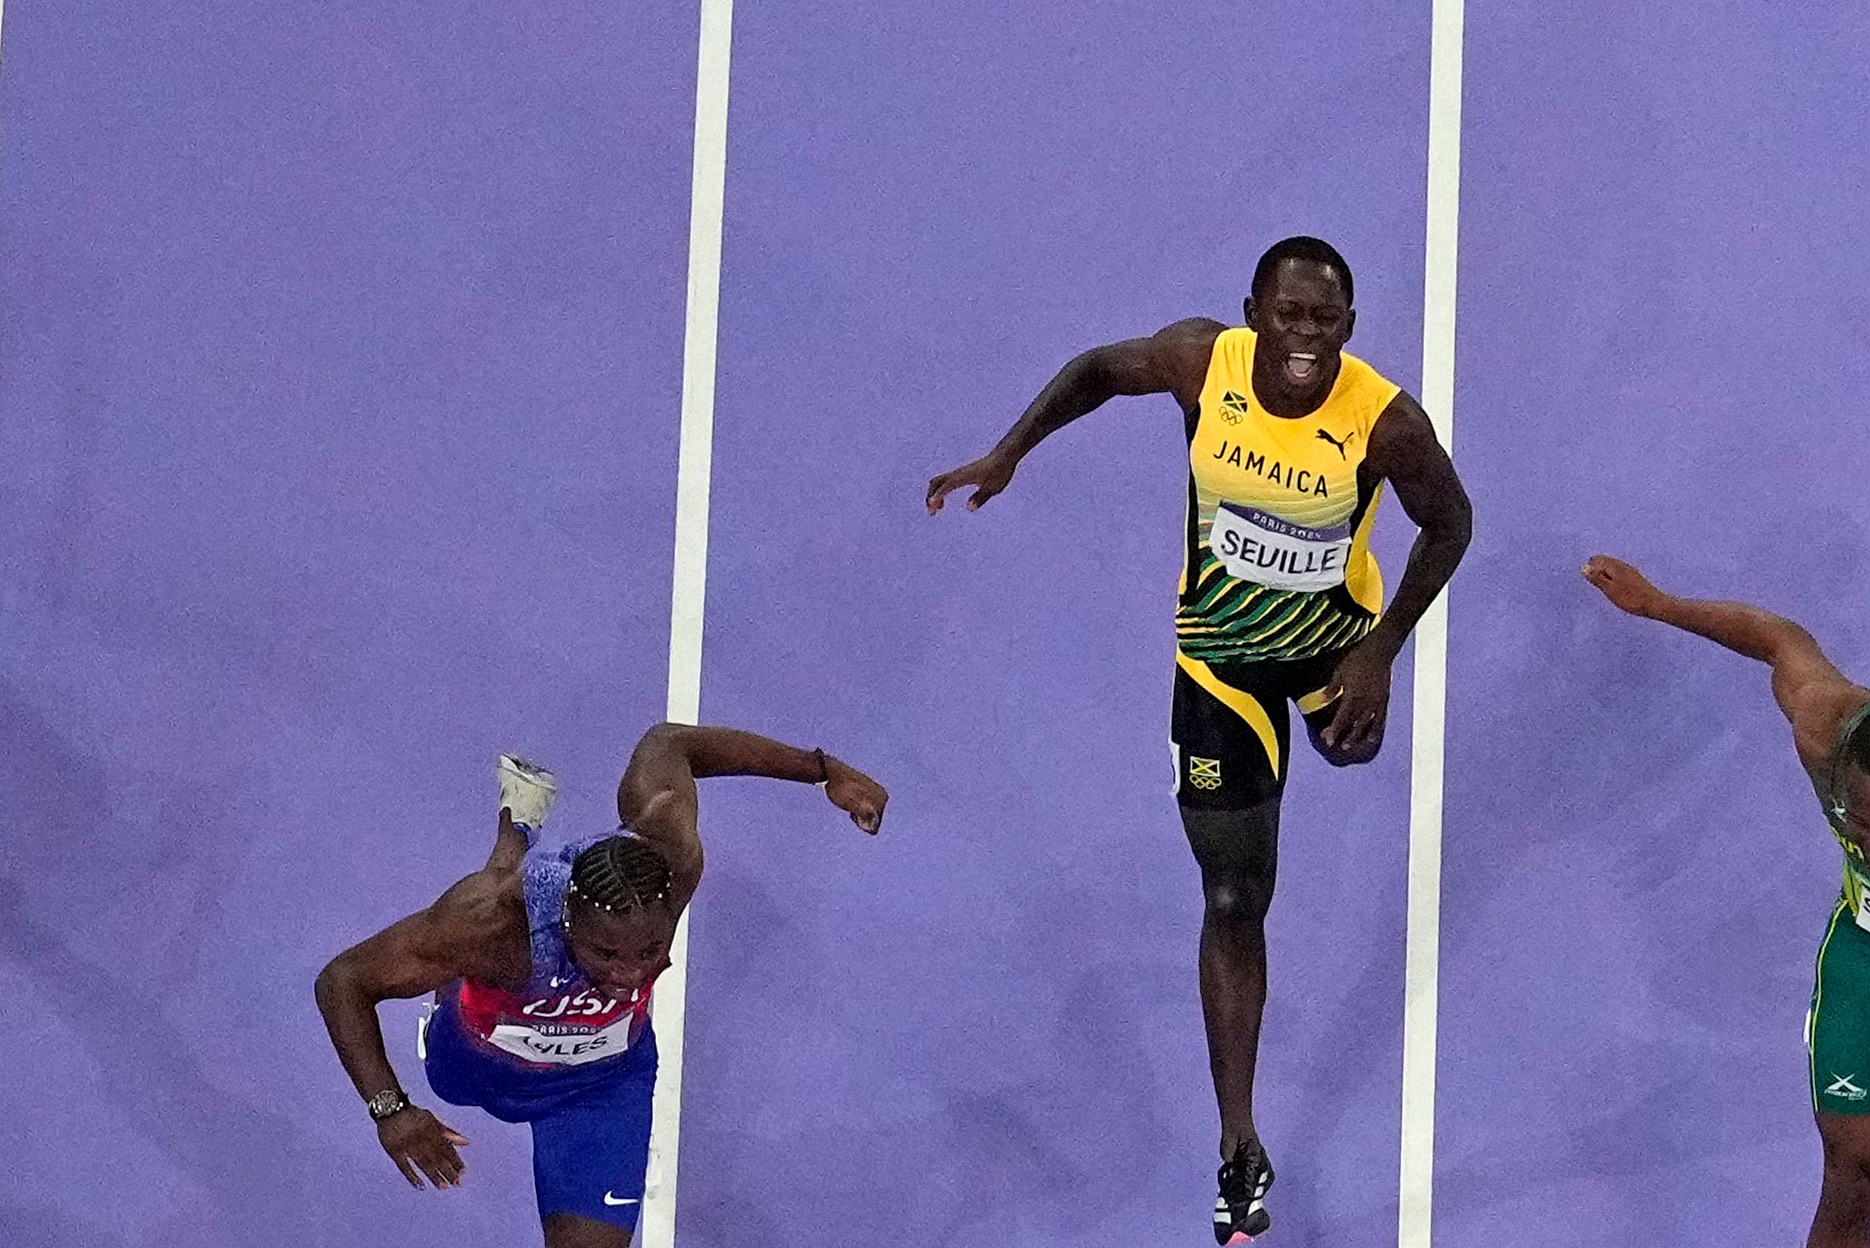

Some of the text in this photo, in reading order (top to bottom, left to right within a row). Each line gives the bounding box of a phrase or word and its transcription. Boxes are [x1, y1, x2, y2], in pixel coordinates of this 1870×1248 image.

[1212, 440, 1329, 498] JAMAICA
[1252, 512, 1289, 533] PARIS
[1220, 529, 1340, 574] SEVILLE
